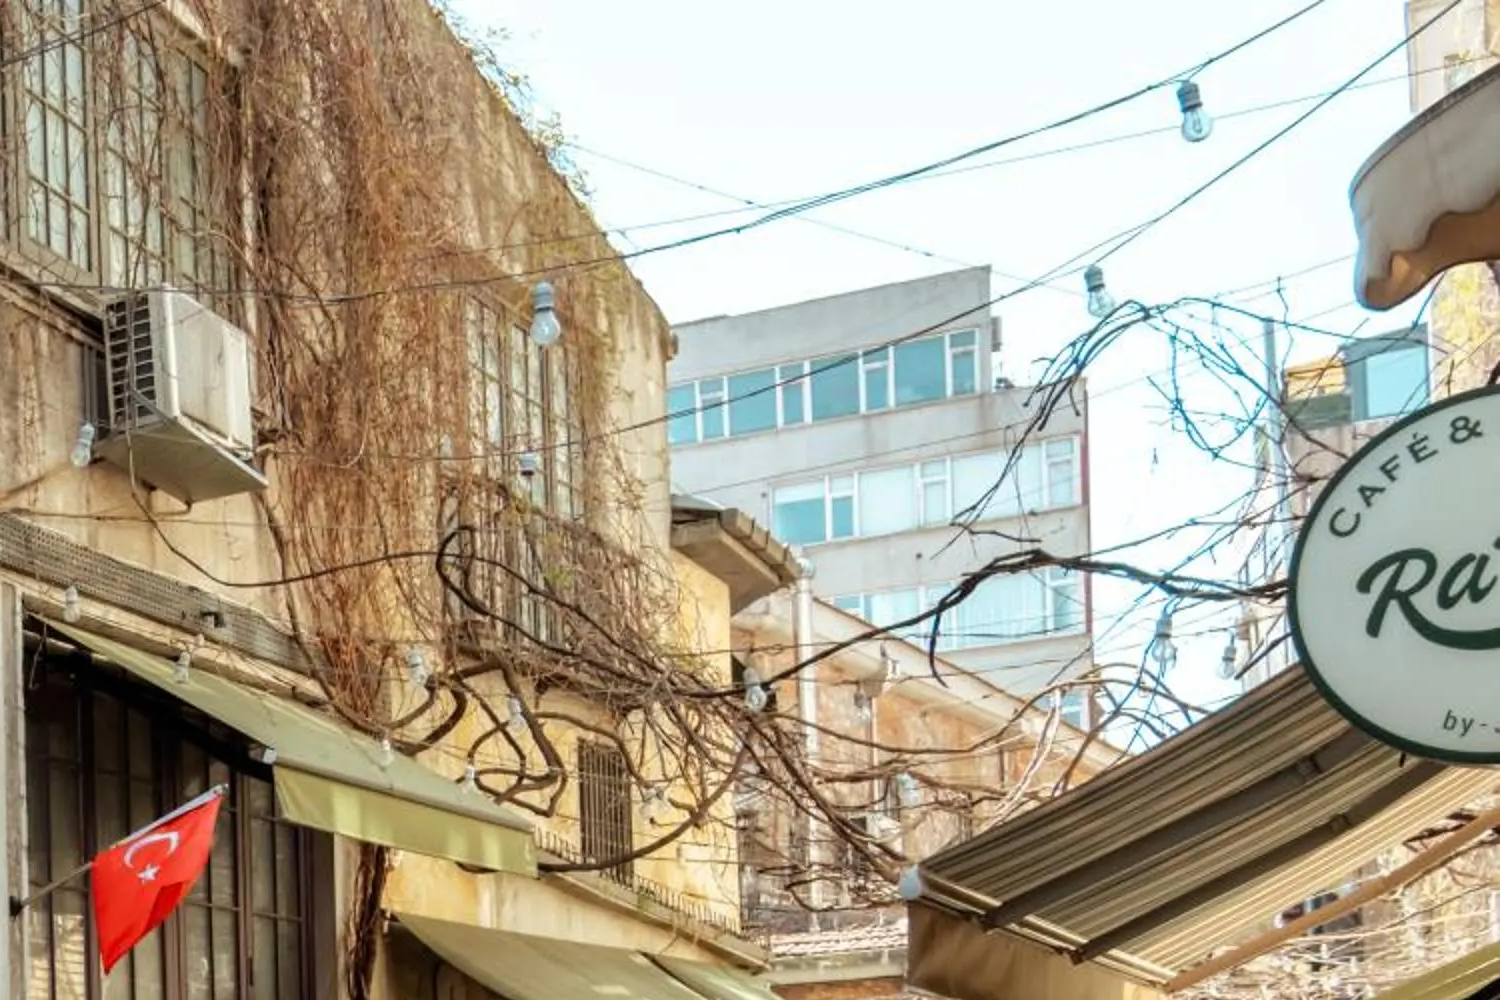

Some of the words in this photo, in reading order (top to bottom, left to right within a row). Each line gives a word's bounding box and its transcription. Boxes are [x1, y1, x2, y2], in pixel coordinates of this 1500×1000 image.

[1329, 432, 1438, 538] CAFÉ
[1449, 415, 1483, 444] &
[1356, 536, 1500, 650] Ra
